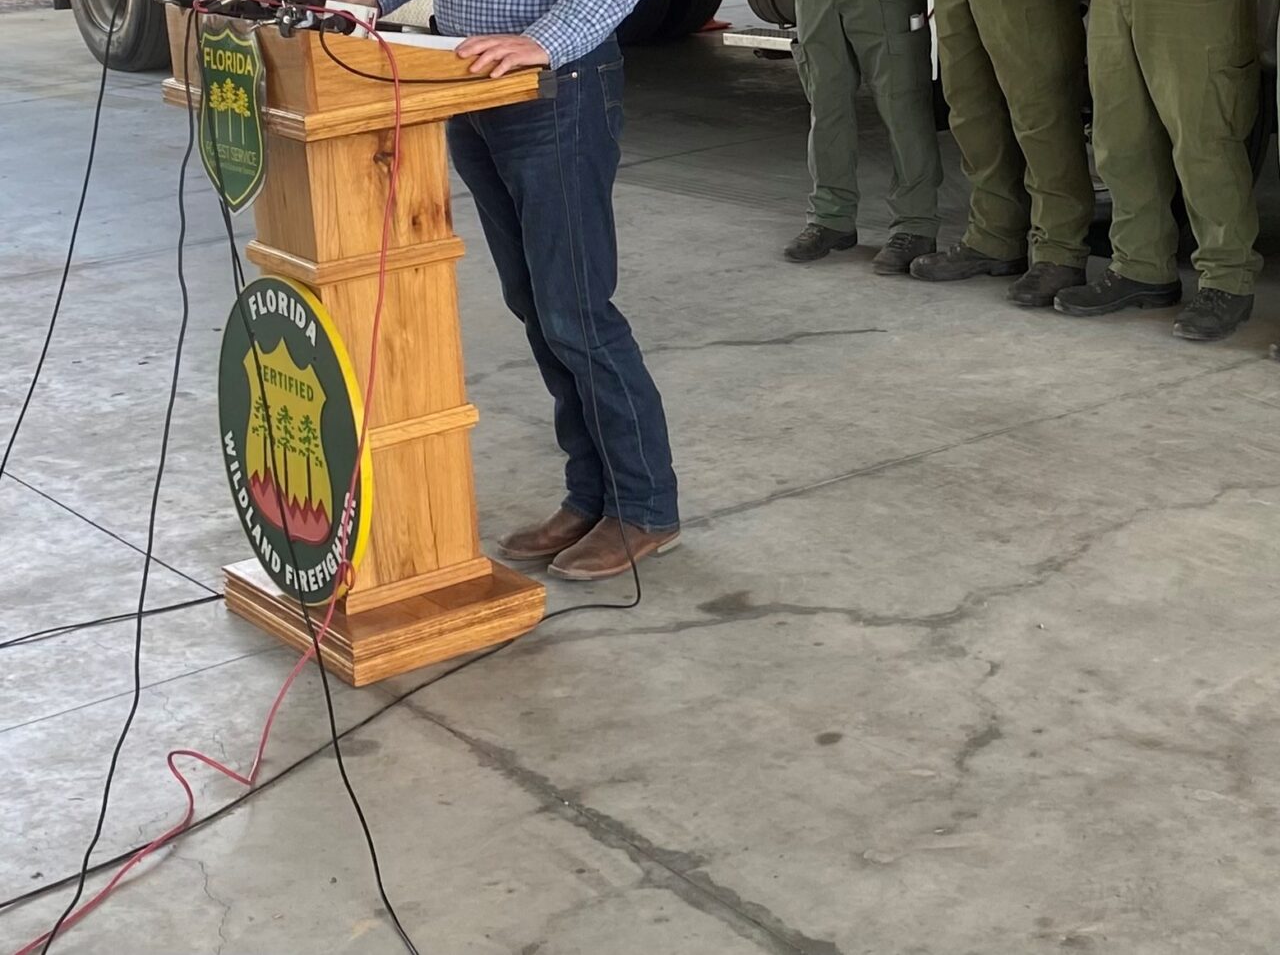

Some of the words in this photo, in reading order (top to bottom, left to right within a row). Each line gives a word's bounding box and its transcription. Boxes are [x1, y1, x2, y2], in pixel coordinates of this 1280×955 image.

[203, 47, 255, 77] FLORIDA
[248, 288, 317, 348] FLORIDA
[257, 363, 314, 403] ERTIFIED
[223, 429, 282, 574] WILDLAND
